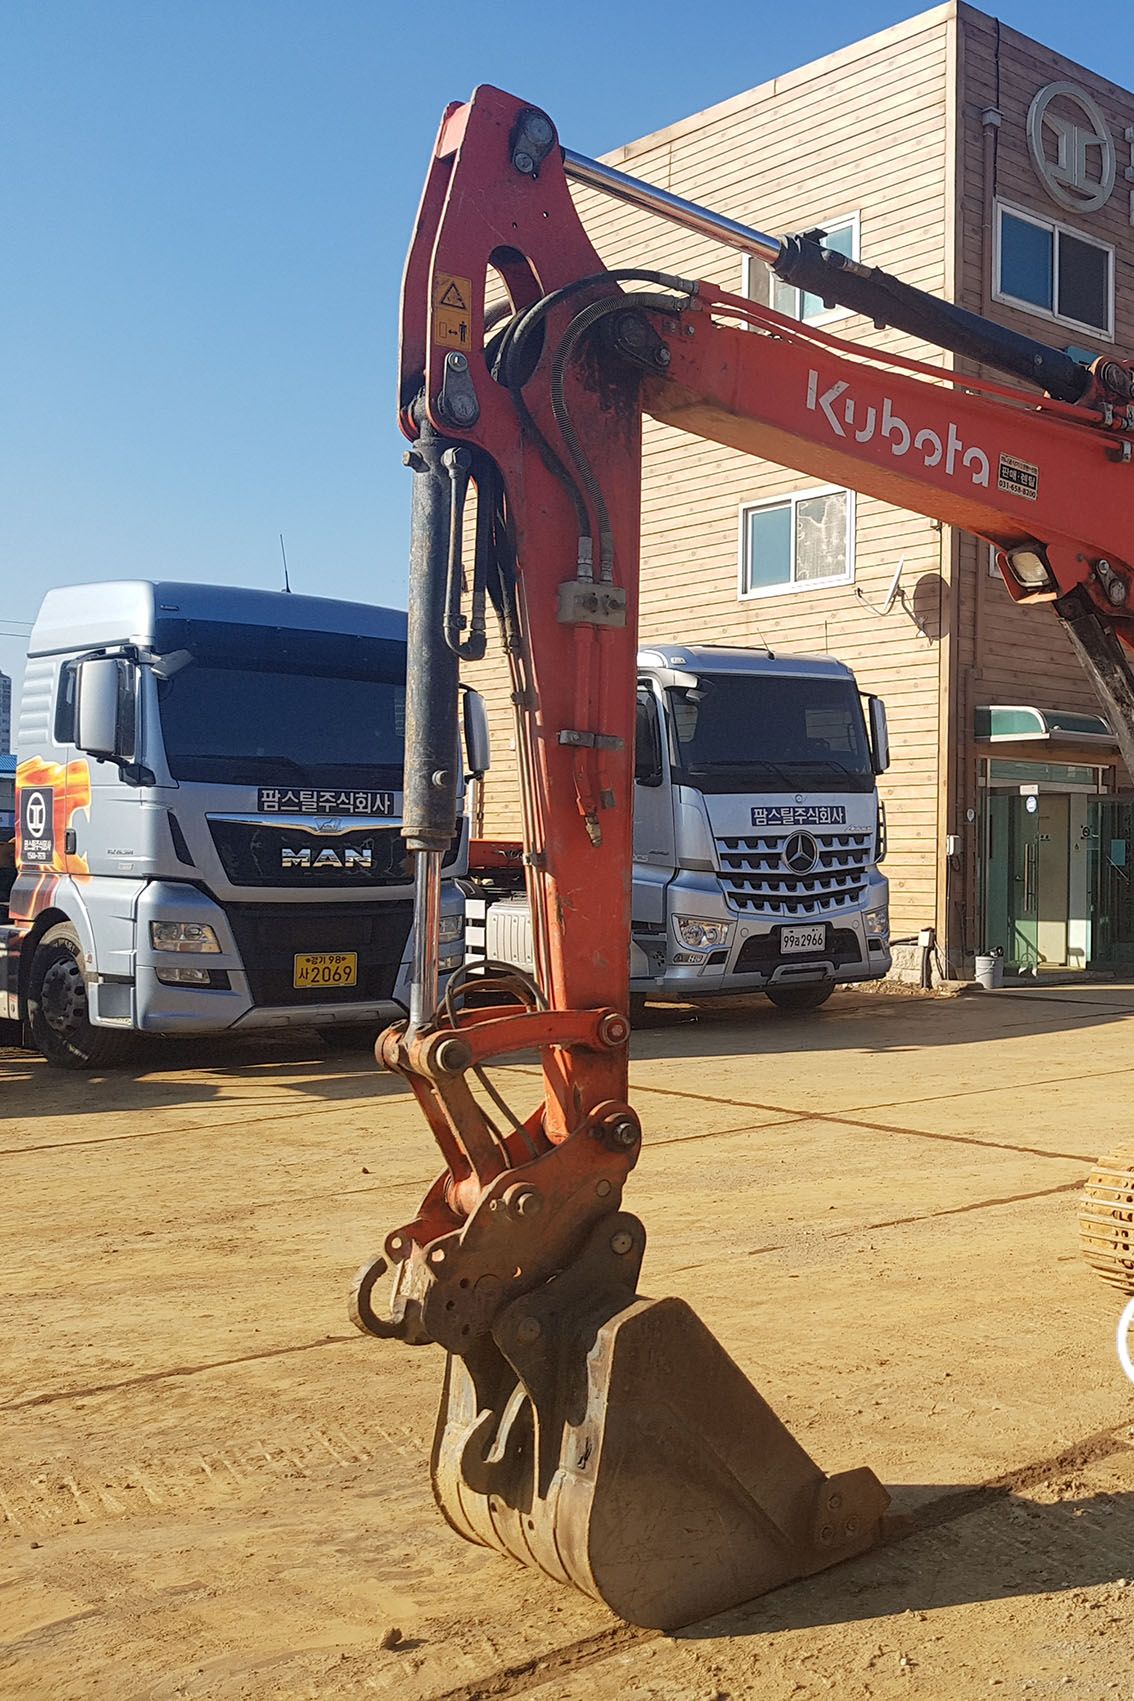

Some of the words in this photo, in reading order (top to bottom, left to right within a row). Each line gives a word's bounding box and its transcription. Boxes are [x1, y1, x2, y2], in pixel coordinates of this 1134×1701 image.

[806, 369, 990, 488] Kubota
[261, 789, 391, 815] 팜스틸주식회사
[753, 807, 843, 826] 팜스틸주식회사
[282, 848, 372, 867] MAN
